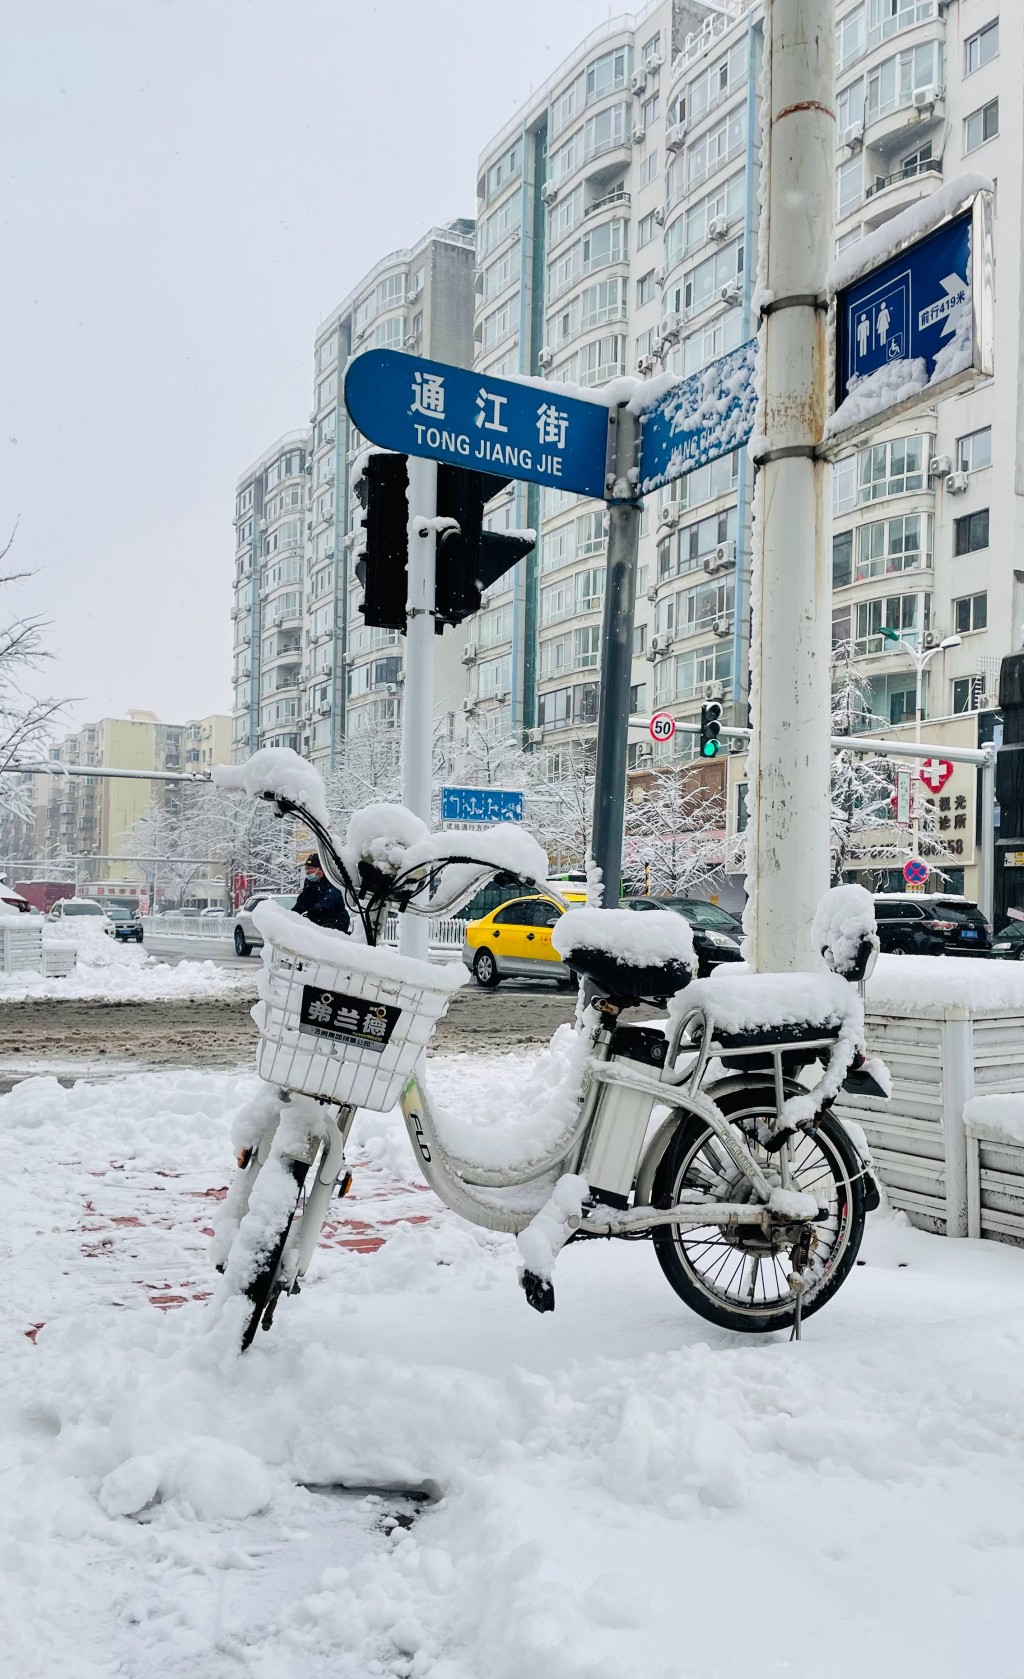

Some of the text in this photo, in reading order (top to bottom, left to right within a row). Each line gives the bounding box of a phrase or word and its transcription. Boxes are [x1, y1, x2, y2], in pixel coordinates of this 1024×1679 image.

[920, 290, 966, 326] 前行419米
[410, 371, 569, 449] 通江街
[414, 424, 563, 477] TONG JIANG JIE
[654, 720, 671, 735] 50
[446, 822, 496, 832] 请按通行方向
[307, 1000, 389, 1037] 弗兰德
[409, 1113, 432, 1163] FLD
